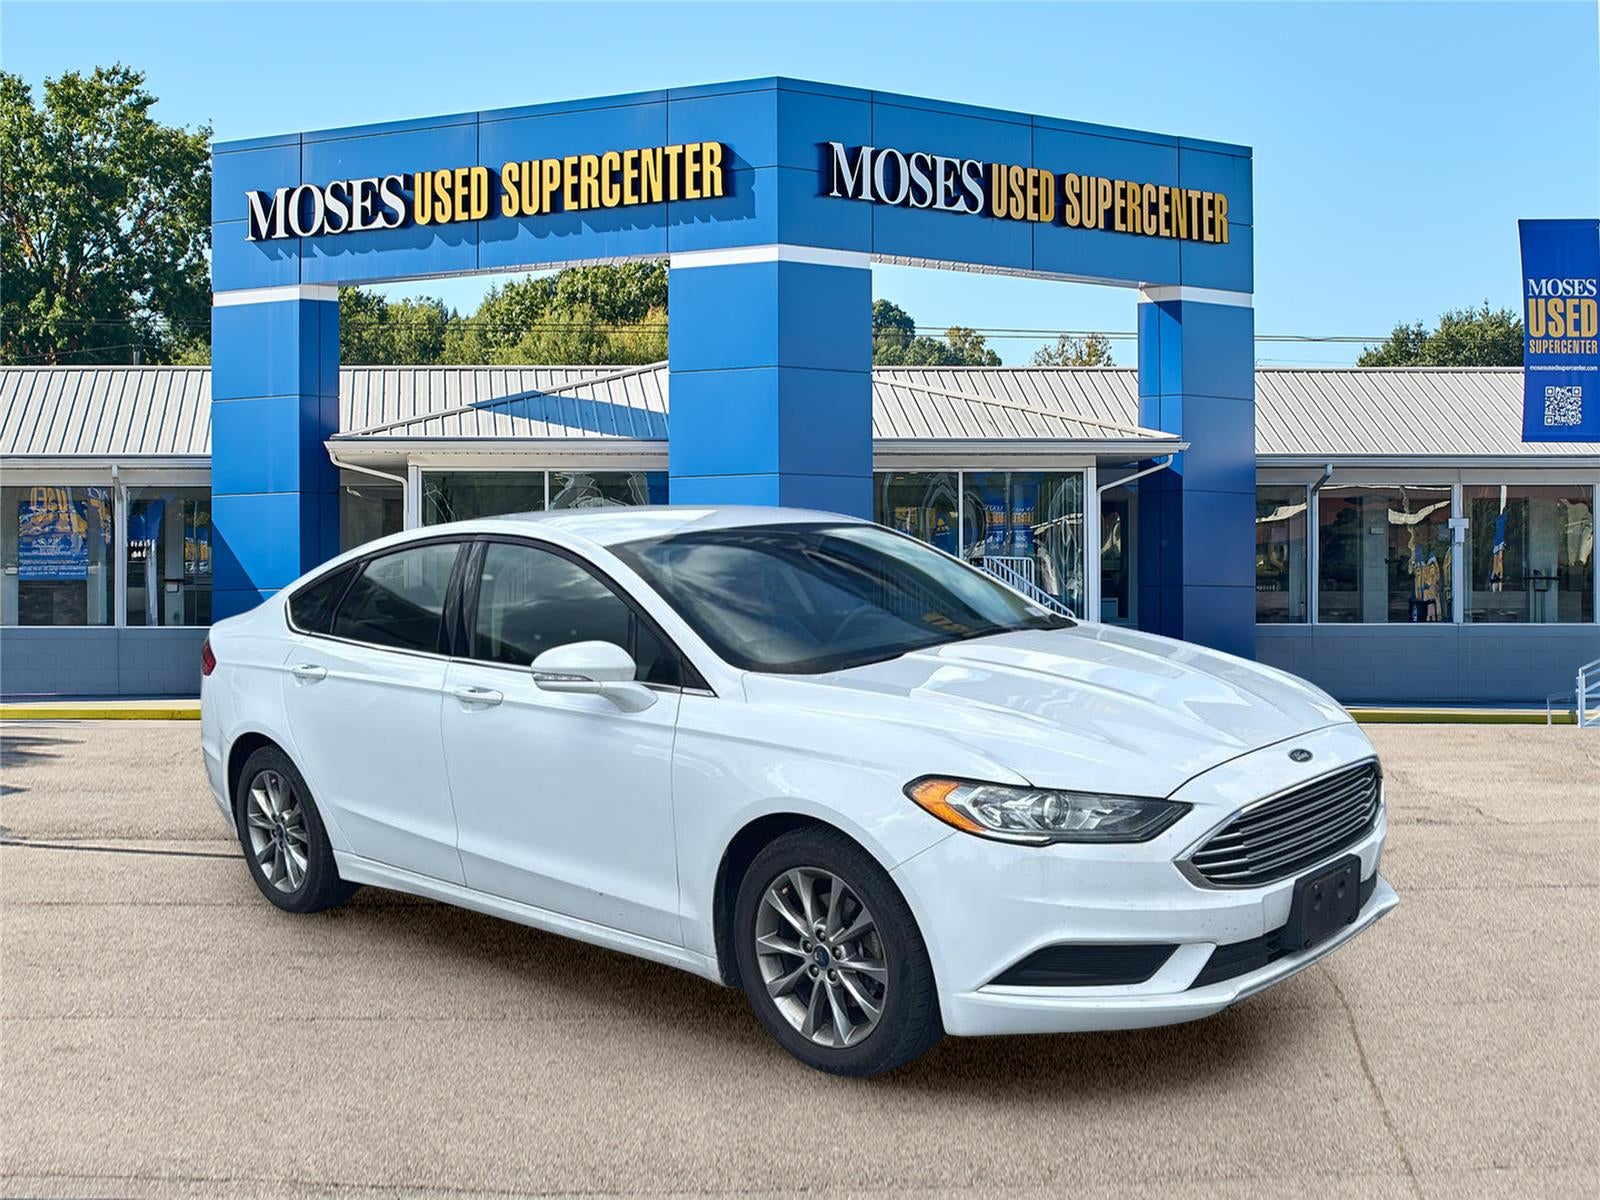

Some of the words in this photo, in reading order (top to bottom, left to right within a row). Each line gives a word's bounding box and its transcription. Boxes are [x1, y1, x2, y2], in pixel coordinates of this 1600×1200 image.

[244, 174, 406, 242] MOSES
[413, 166, 489, 226] USED
[500, 141, 725, 218] SUPERCENTER
[829, 141, 985, 215] MOSES
[991, 163, 1056, 223] USED
[1065, 173, 1230, 244] SUPERCENTER
[1528, 278, 1597, 297] MOSES
[1528, 298, 1598, 338] USED
[1529, 339, 1598, 355] SUPERCENTER
